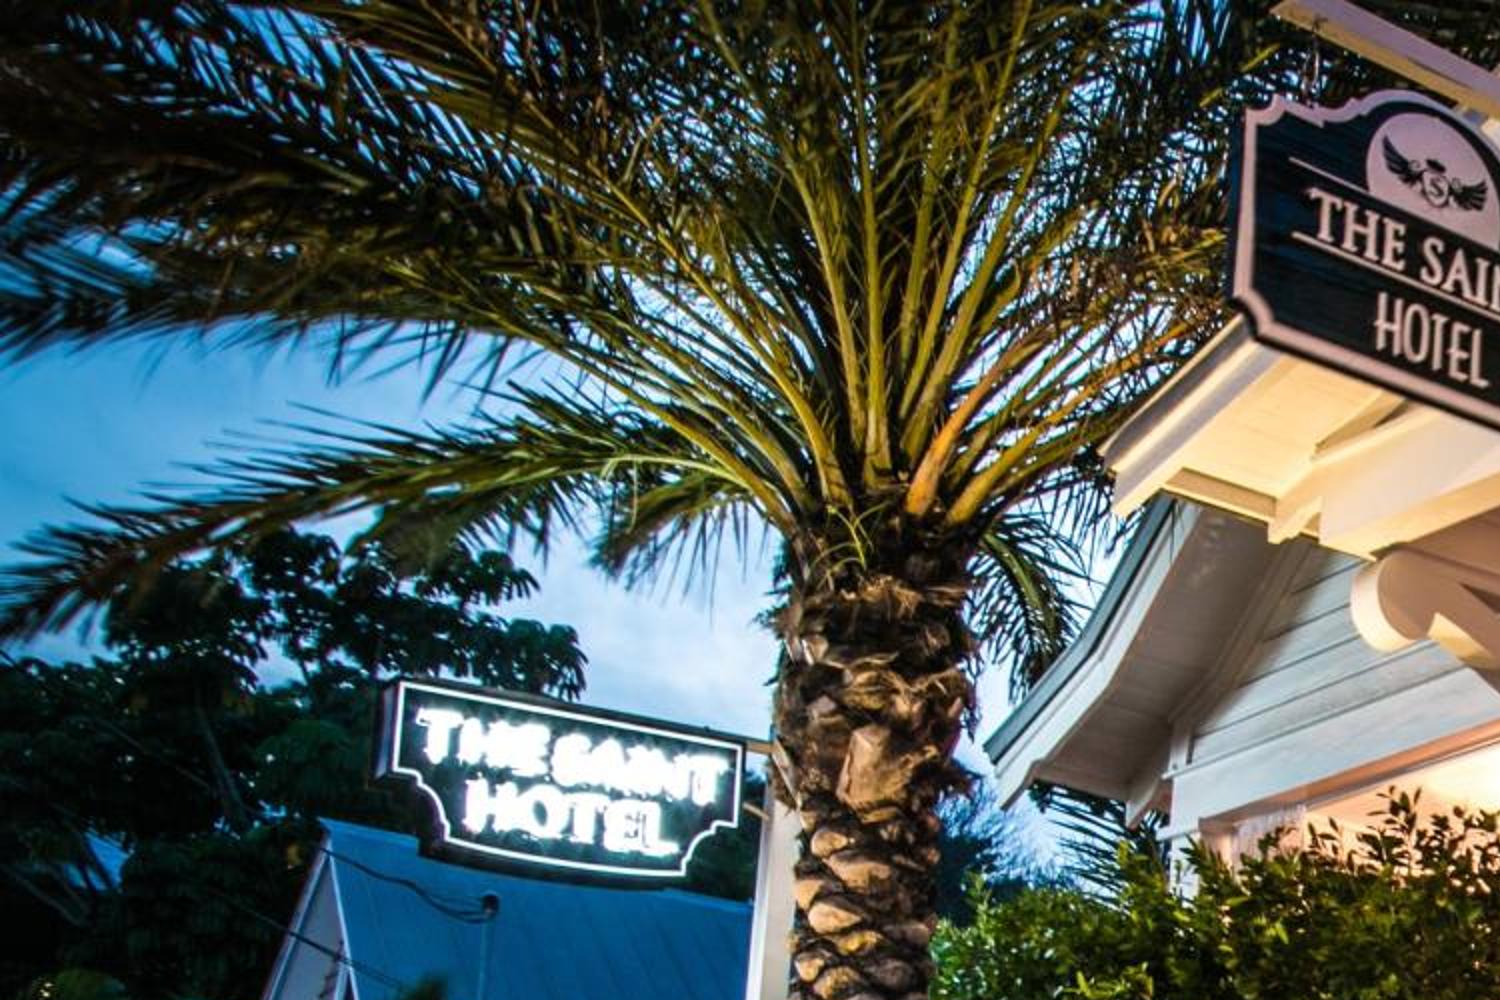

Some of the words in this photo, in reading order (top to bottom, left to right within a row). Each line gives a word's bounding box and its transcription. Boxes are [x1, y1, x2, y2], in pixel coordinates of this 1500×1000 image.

[1307, 187, 1407, 271] THE
[1374, 291, 1490, 389] HOTEL
[417, 706, 550, 777] THE
[461, 773, 680, 857] HOTEL
